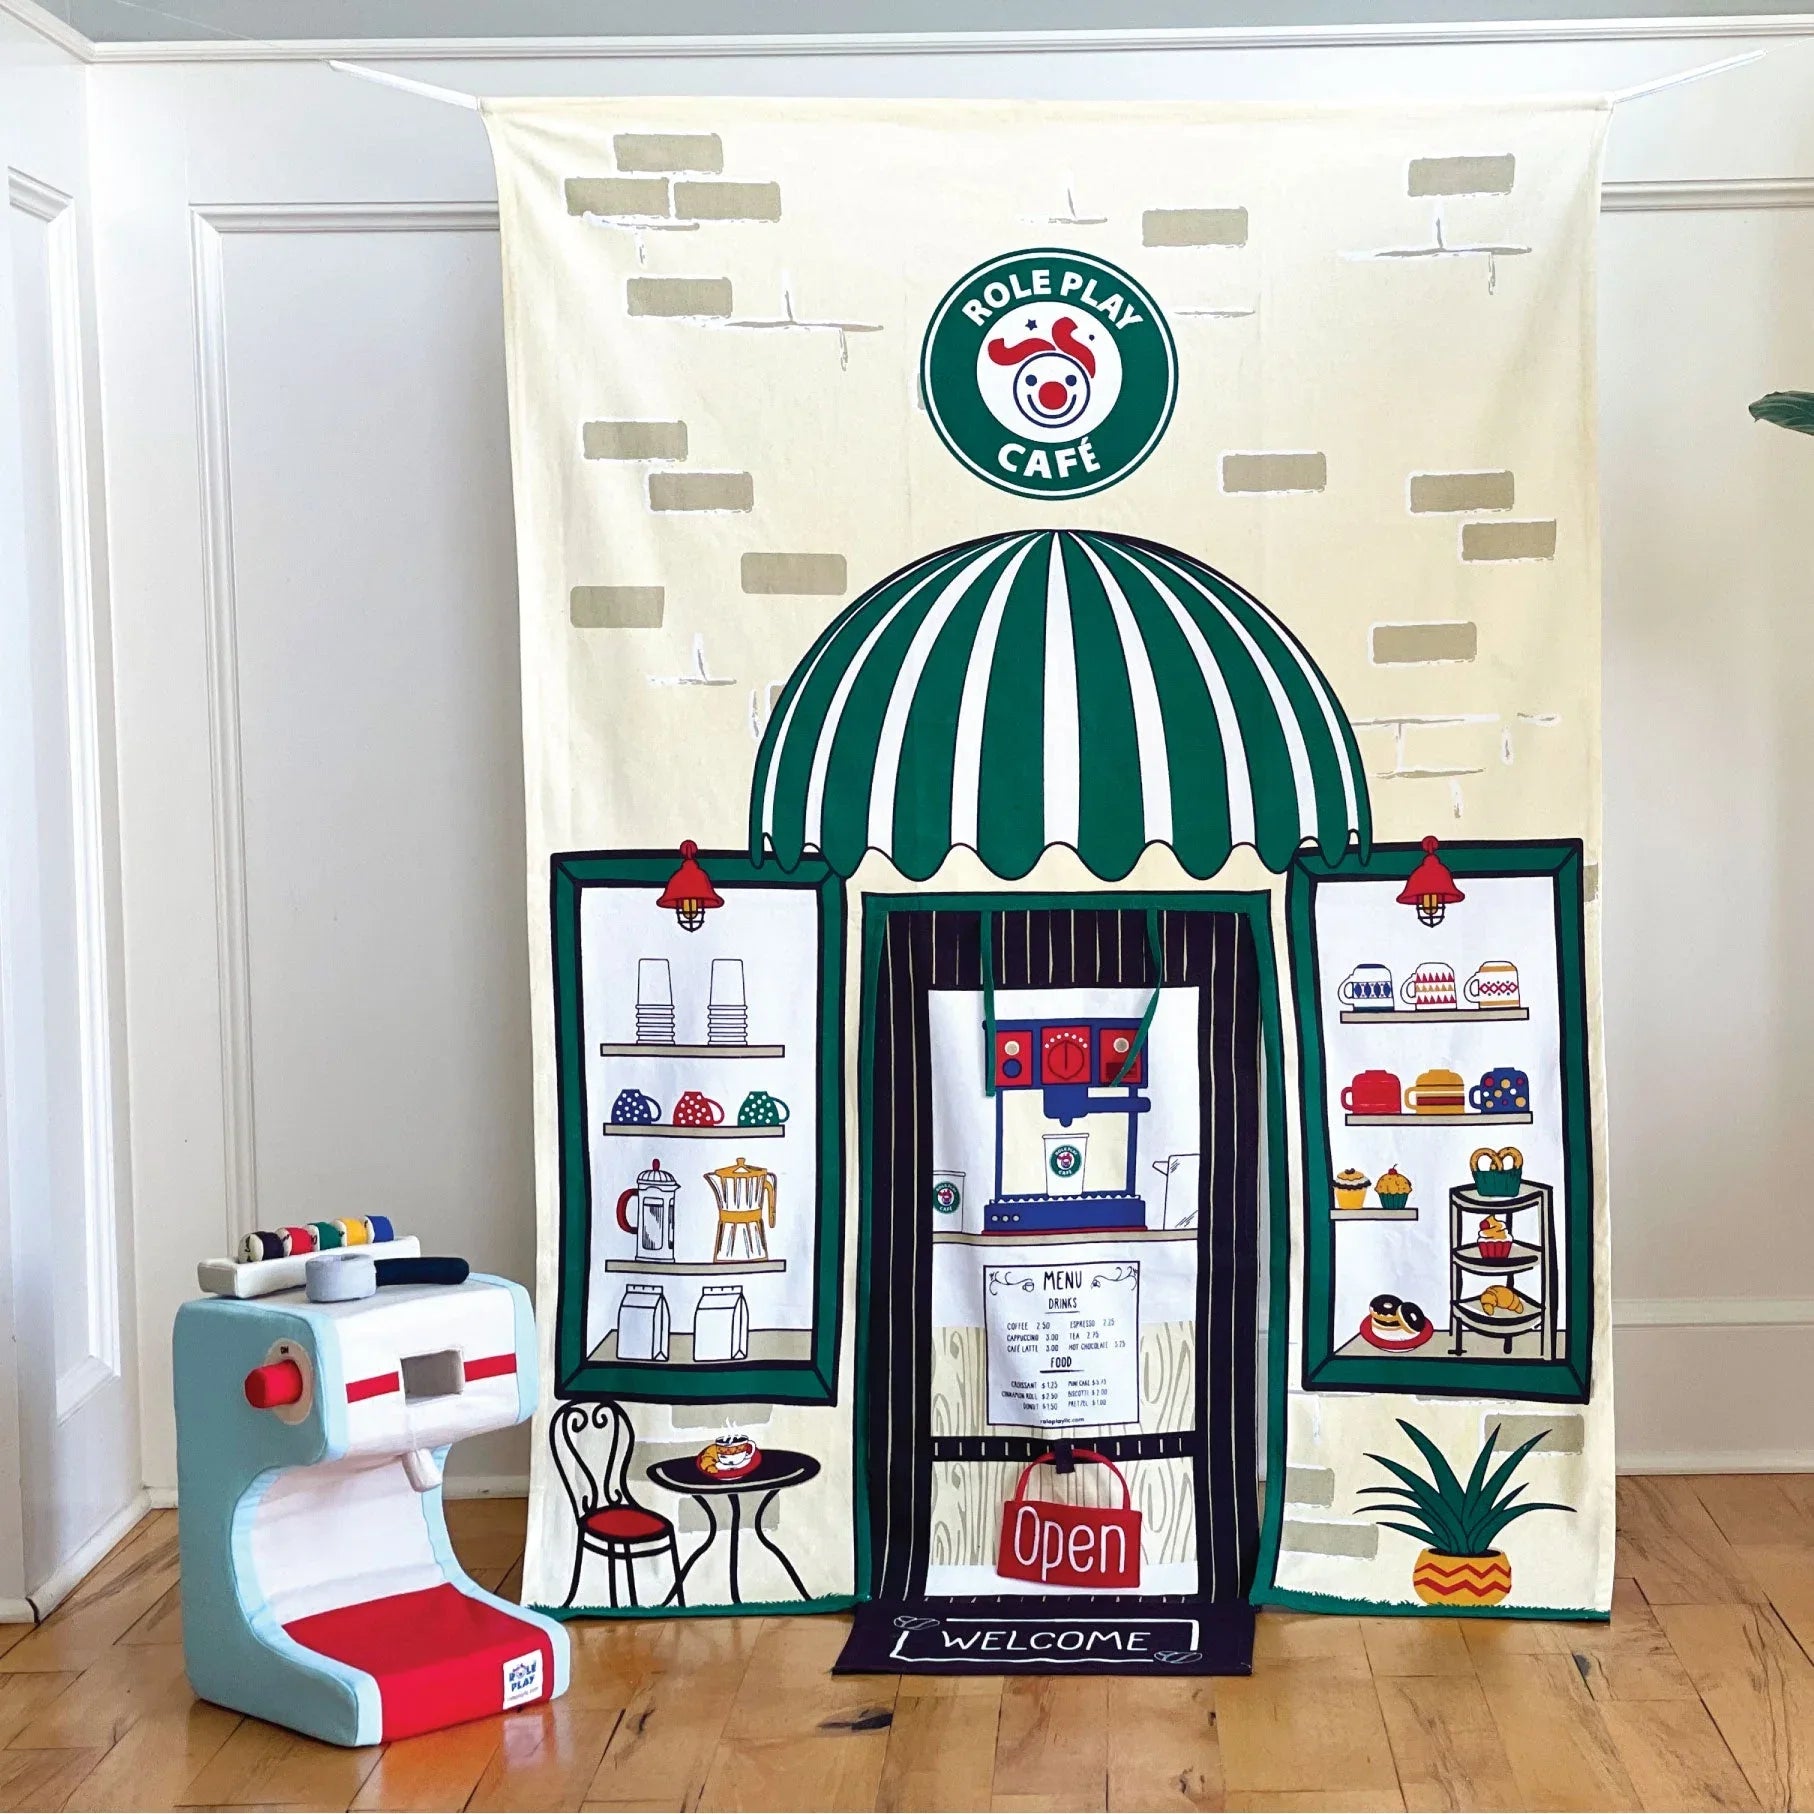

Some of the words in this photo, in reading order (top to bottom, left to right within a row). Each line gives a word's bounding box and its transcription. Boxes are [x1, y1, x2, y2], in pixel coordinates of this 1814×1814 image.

[961, 269, 1052, 327] ROLE
[1060, 271, 1144, 330] PLAY
[998, 436, 1101, 479] CAFÉ
[1043, 1270, 1082, 1291] MENU
[1048, 1297, 1077, 1310] DRINKS
[1006, 1322, 1028, 1331] COFFEE
[1069, 1320, 1096, 1329] ESPRESSO
[1006, 1334, 1039, 1342] CAPPUCCINO
[1069, 1332, 1080, 1341] TEA
[1050, 1356, 1072, 1368] FOOD
[1013, 1504, 1127, 1582] Open
[941, 1629, 1151, 1652] WELCOME
[511, 1675, 535, 1693] PLAY
